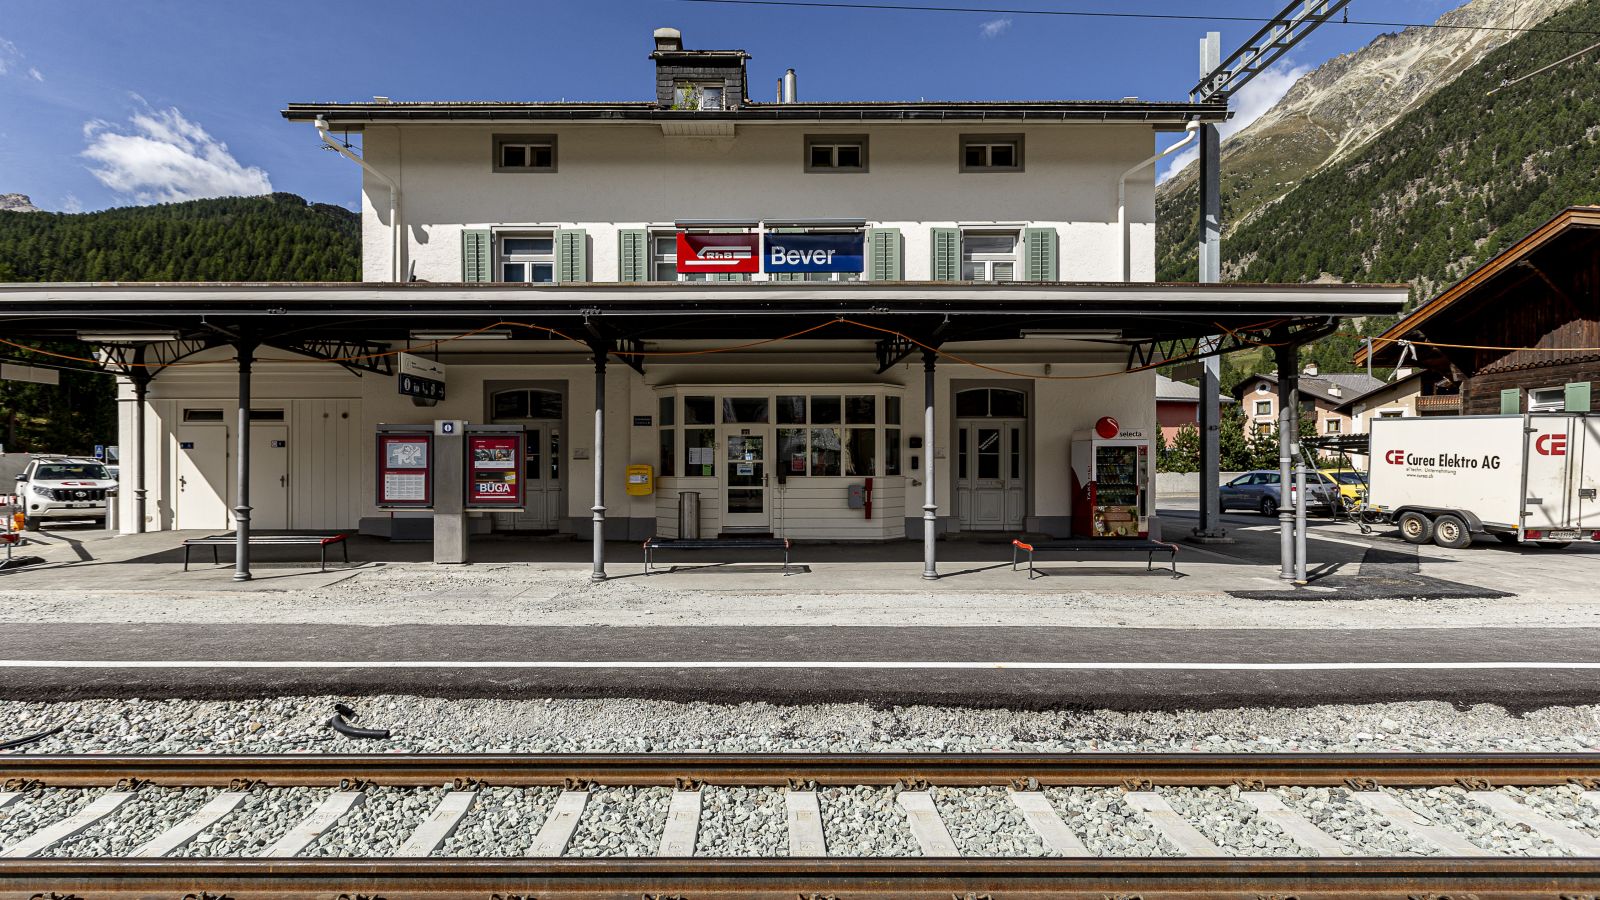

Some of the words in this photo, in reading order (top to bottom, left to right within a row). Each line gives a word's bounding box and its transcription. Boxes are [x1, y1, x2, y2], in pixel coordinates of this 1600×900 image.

[771, 246, 836, 265] Bever
[1536, 434, 1566, 456] CE
[1385, 450, 1404, 465] CE
[1406, 453, 1436, 467] Curea
[1438, 453, 1478, 469] Elektro
[1481, 455, 1501, 470] AG
[480, 481, 511, 492] BÜGA
